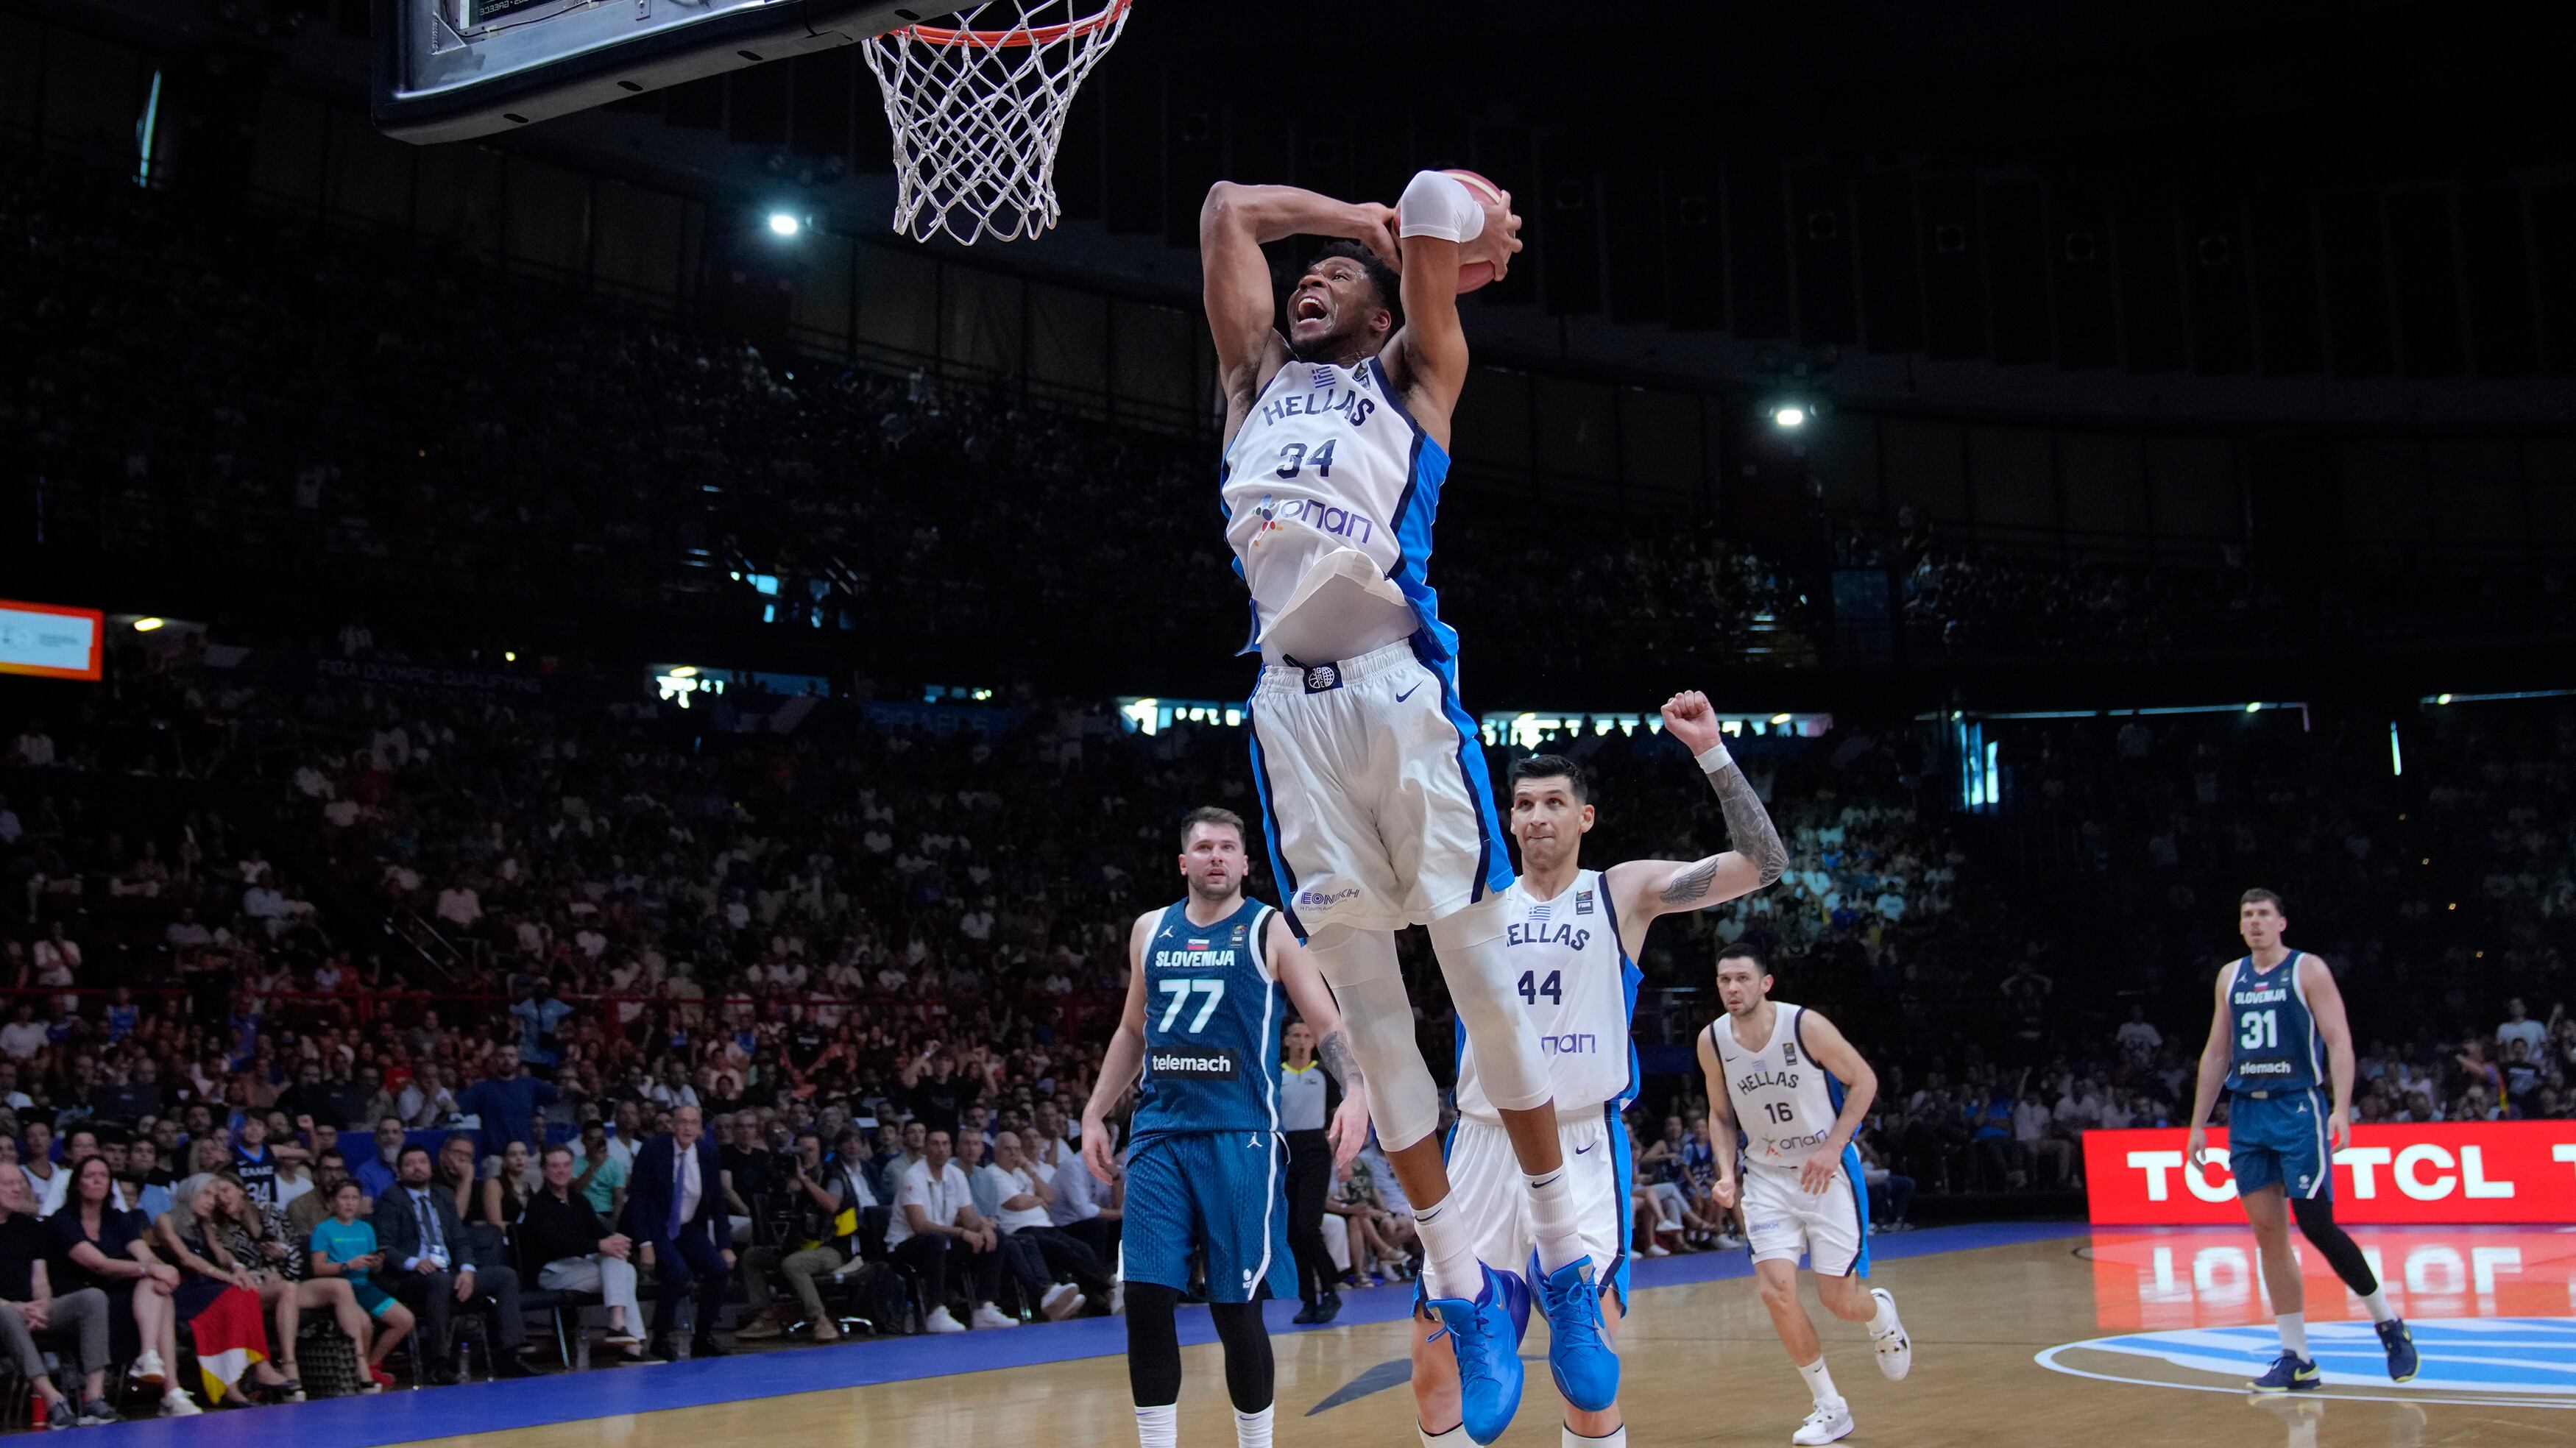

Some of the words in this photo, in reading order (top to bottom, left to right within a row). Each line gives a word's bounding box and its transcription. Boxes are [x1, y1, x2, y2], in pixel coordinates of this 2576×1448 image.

[1262, 388, 1375, 427] HELLAS
[1276, 439, 1337, 479] 34
[1507, 923, 1590, 951] ELLAS
[1156, 950, 1235, 968] SLOVENIJA
[1518, 970, 1562, 1005] 44
[2234, 988, 2287, 1005] SLOVENIJA
[1158, 979, 1225, 1034] 77
[2240, 1009, 2278, 1049] 31
[1152, 1054, 1231, 1072] telemach
[1737, 1071, 1800, 1095] HELLAS
[1764, 1102, 1793, 1124] 16
[2127, 1148, 2238, 1202] TC
[2332, 1143, 2515, 1201] TCL
